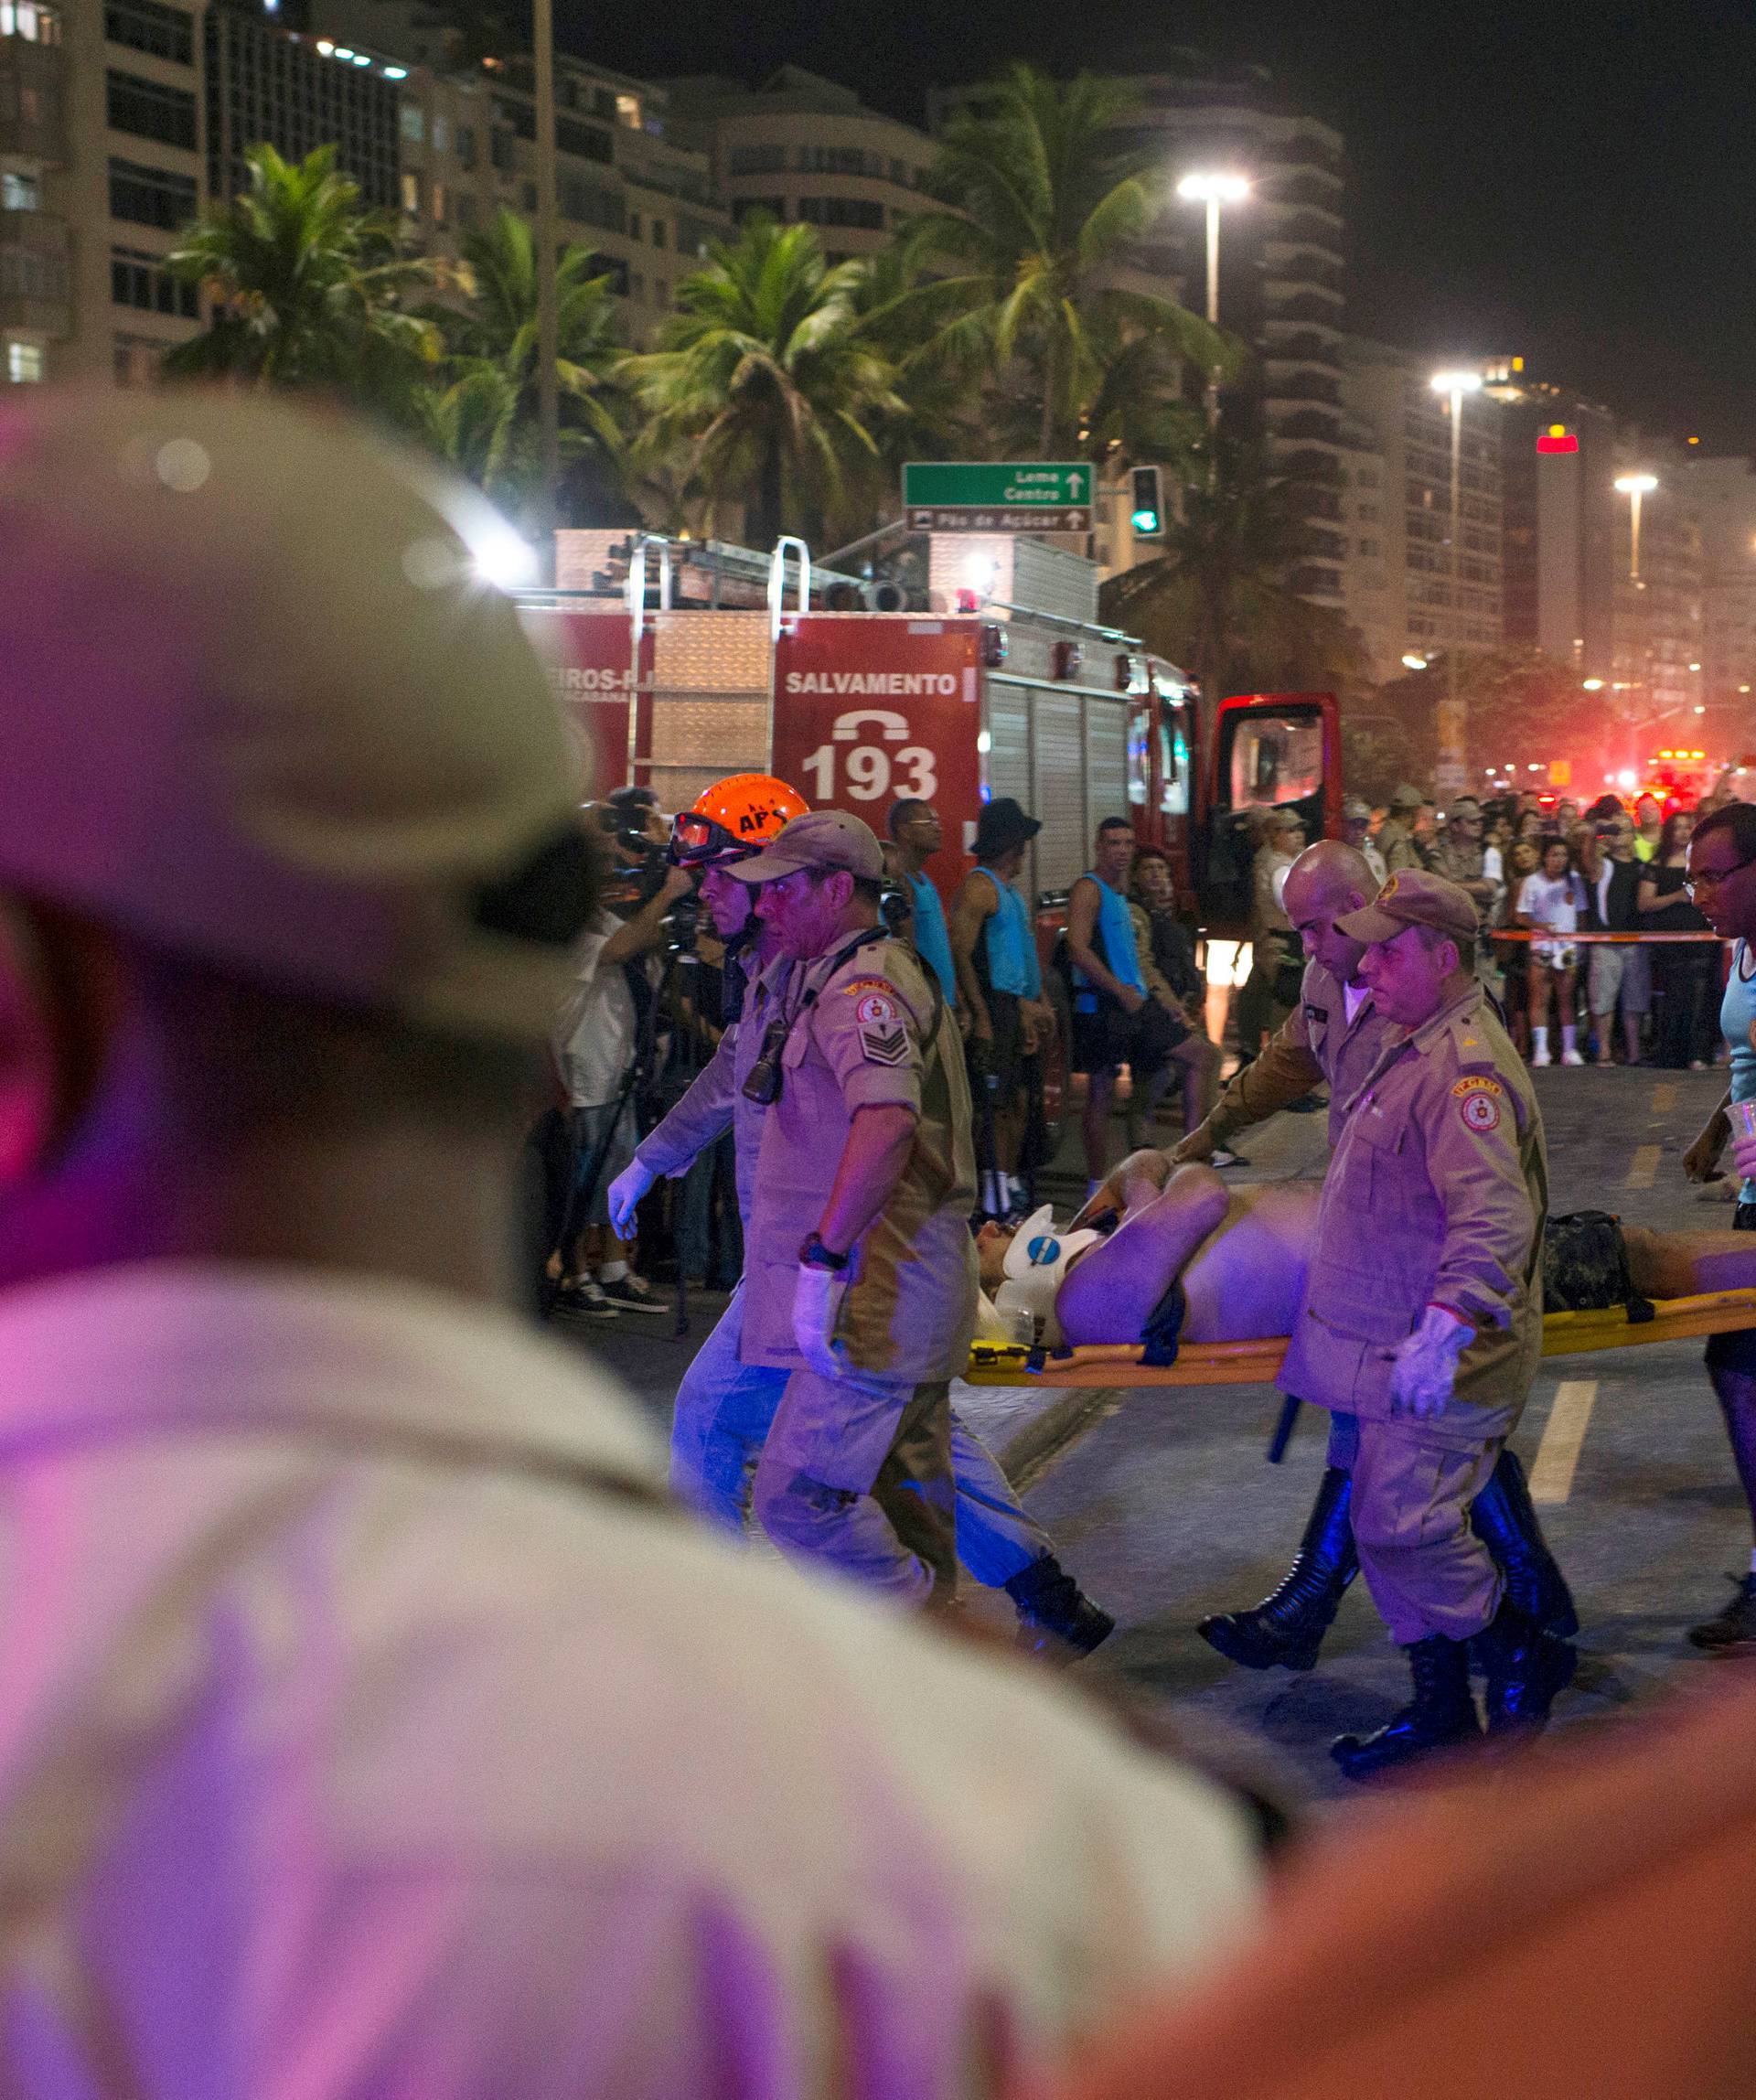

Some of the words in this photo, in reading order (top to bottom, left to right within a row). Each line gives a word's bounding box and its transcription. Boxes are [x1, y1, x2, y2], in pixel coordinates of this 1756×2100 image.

[1015, 471, 1060, 484] Leme
[1004, 487, 1060, 500] Centro
[974, 513, 994, 527] de
[786, 671, 958, 696] SALVAMENTO
[802, 745, 938, 801] 193
